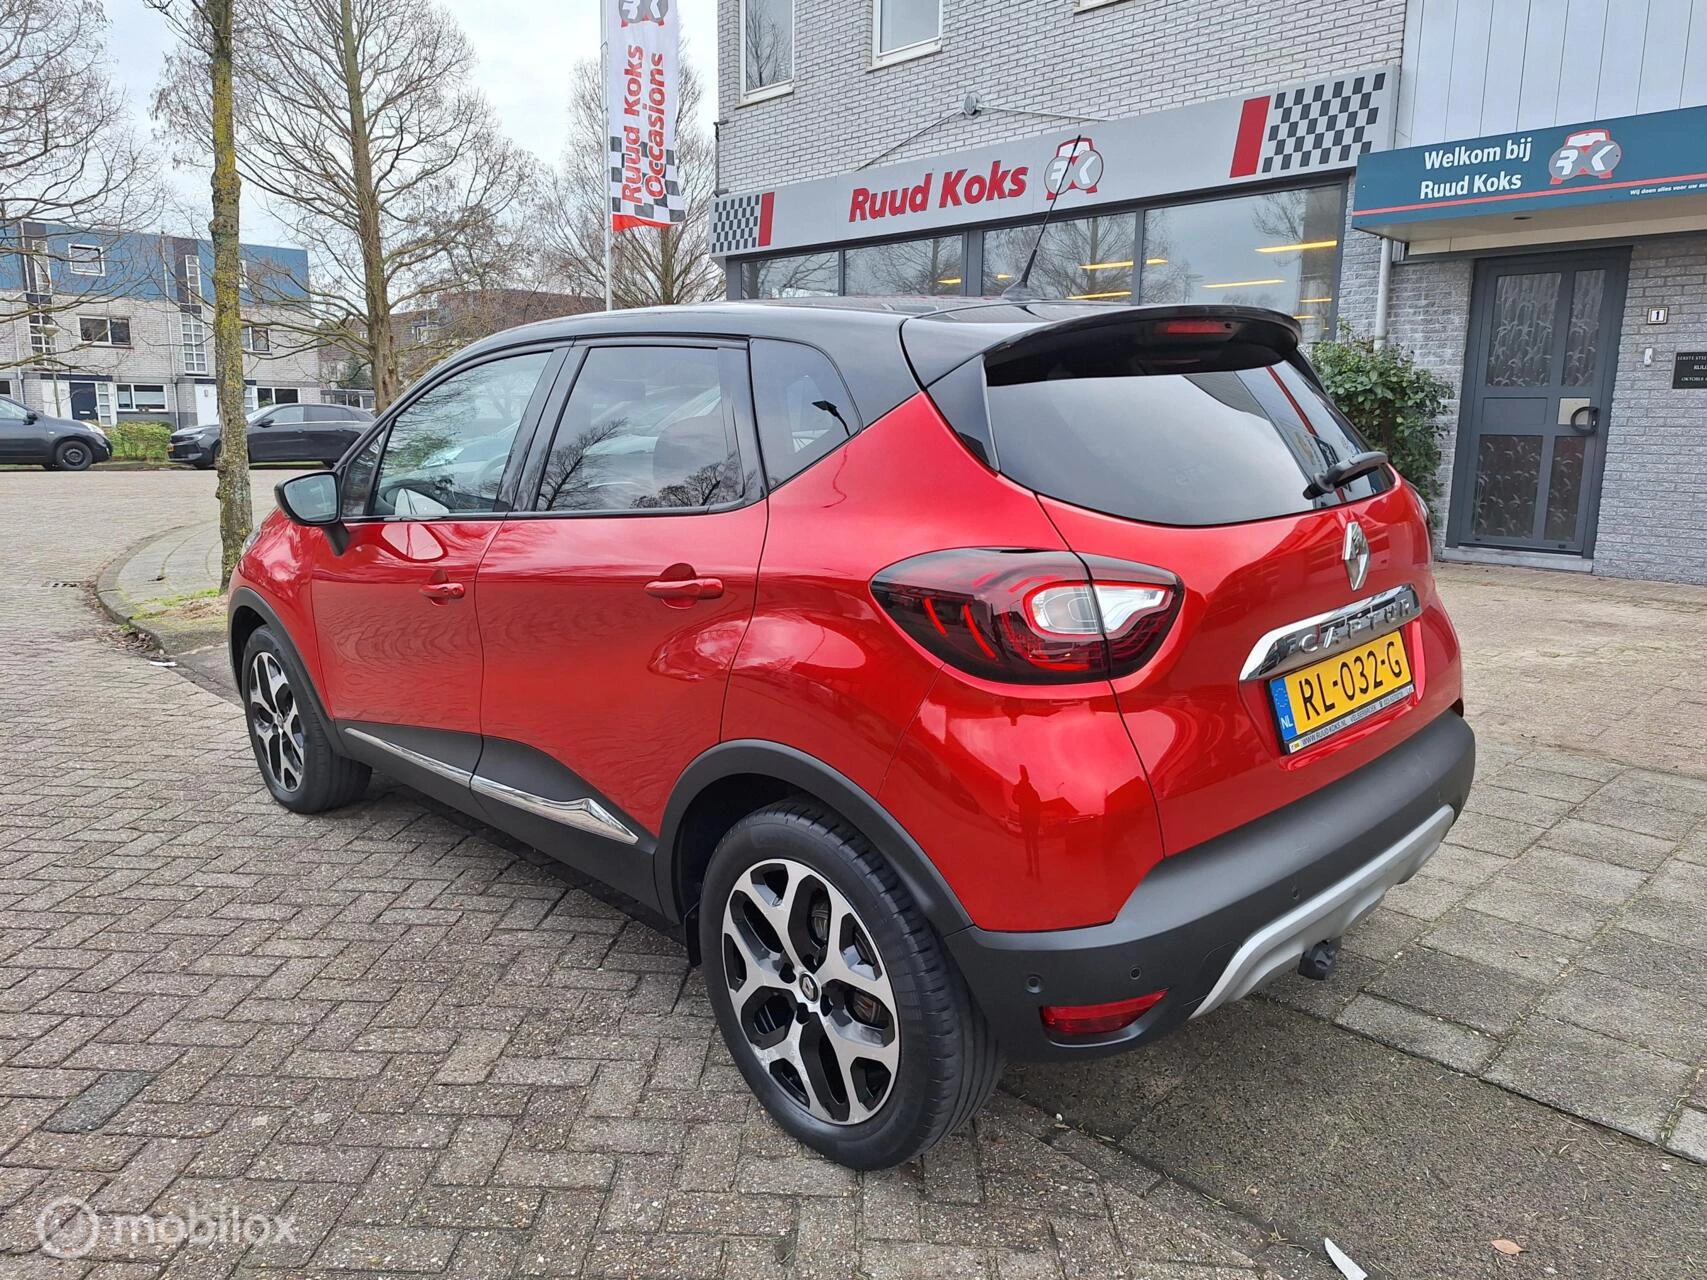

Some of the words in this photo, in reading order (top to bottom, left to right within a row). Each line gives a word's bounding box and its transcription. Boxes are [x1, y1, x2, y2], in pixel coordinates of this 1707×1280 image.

[624, 44, 644, 117] Koks
[642, 52, 666, 199] Occasions
[1424, 141, 1501, 170] Welkom
[1505, 137, 1533, 163] bij
[622, 126, 644, 204] Ruud
[848, 172, 934, 223] Ruud
[939, 160, 1030, 209] Koks
[1419, 176, 1469, 200] Ruud
[1473, 171, 1522, 194] Koks
[1299, 599, 1410, 653] CAPTUR
[1298, 641, 1403, 721] RL-032-G
[1280, 716, 1294, 729] NL
